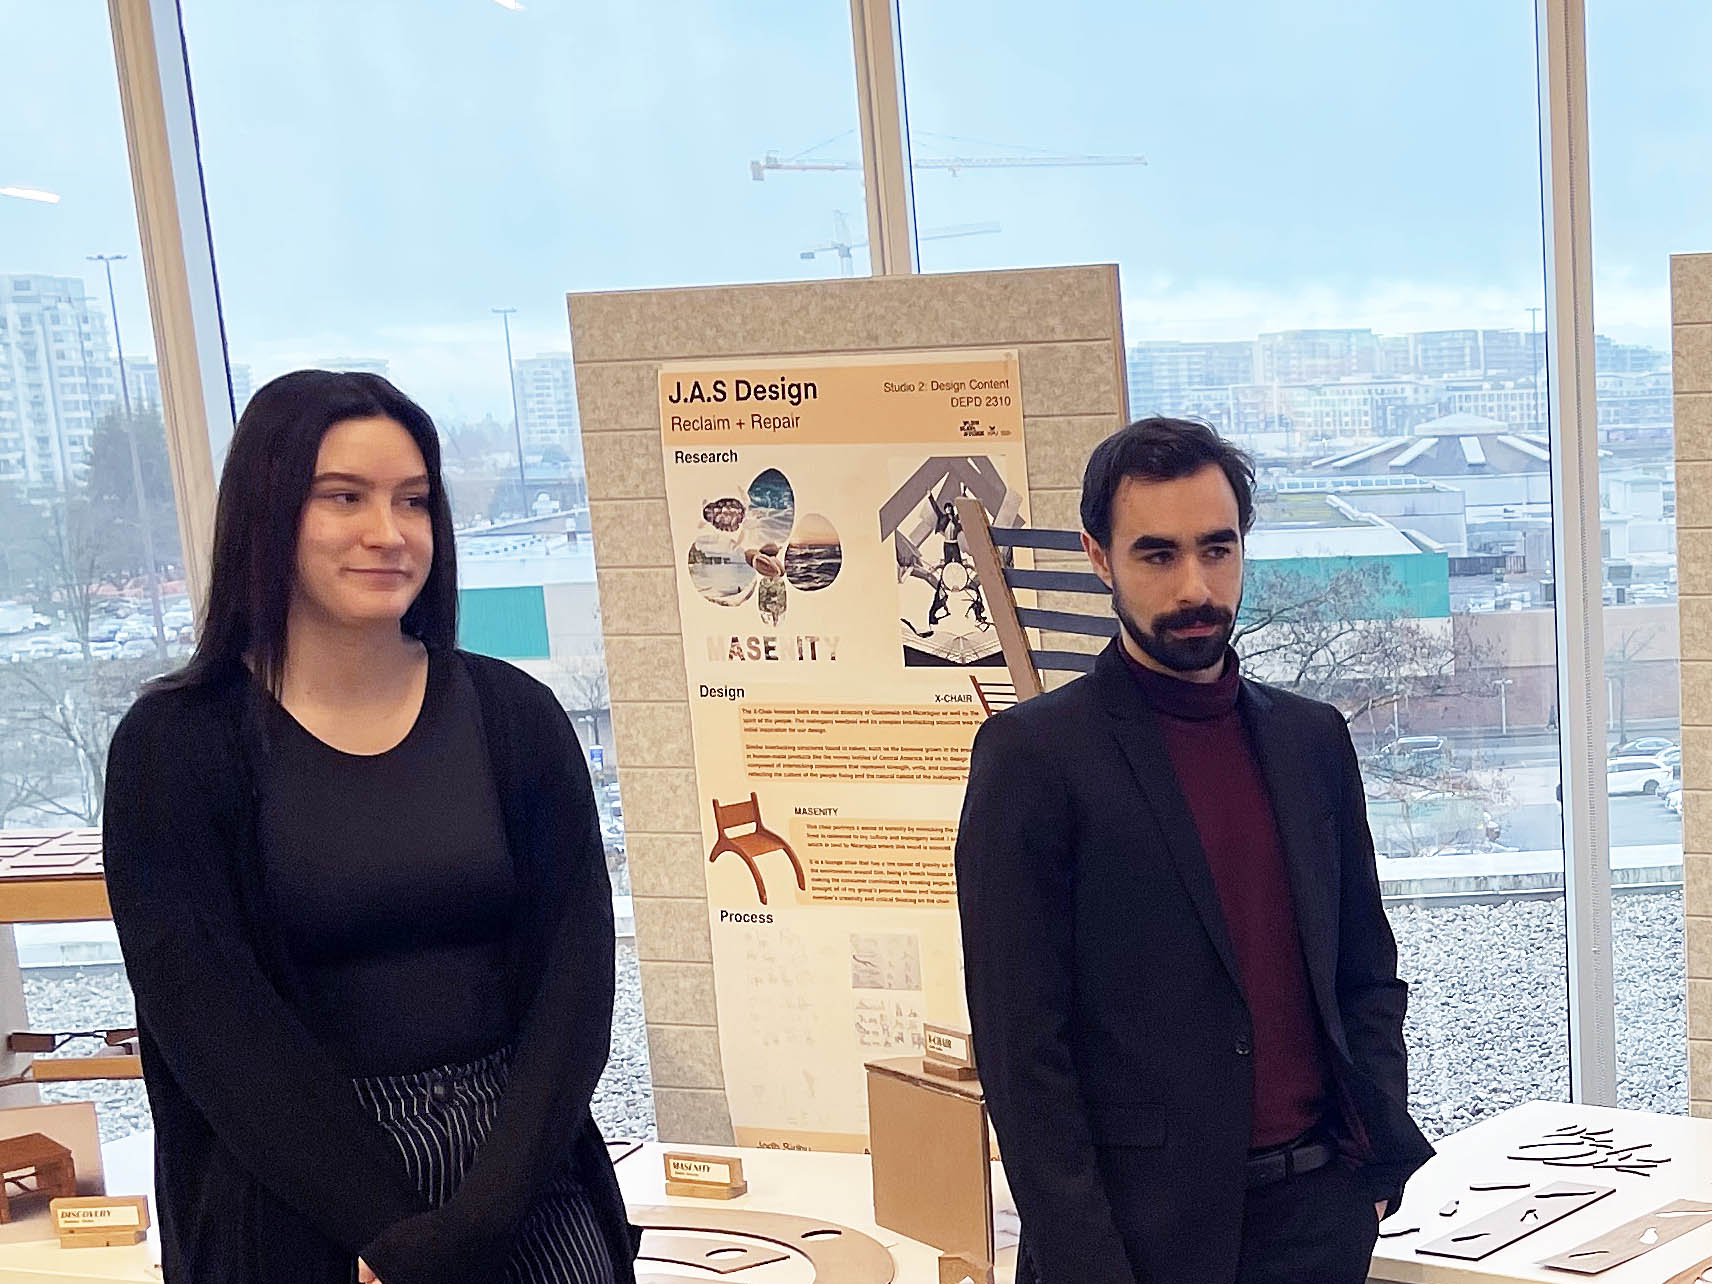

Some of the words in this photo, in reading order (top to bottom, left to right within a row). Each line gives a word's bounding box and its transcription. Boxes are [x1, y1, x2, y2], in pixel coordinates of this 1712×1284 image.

[669, 380, 726, 403] J.A.S
[735, 377, 817, 406] Design
[884, 382, 915, 392] Studio
[931, 381, 965, 393] Design
[969, 379, 1009, 390] Content
[951, 397, 982, 408] DEPD
[986, 396, 1011, 406] 2310
[671, 415, 730, 432] Reclaim
[736, 419, 745, 429] +
[751, 412, 800, 432] Repair
[675, 449, 738, 464] Research
[700, 685, 745, 701] Design
[720, 910, 774, 924] Process
